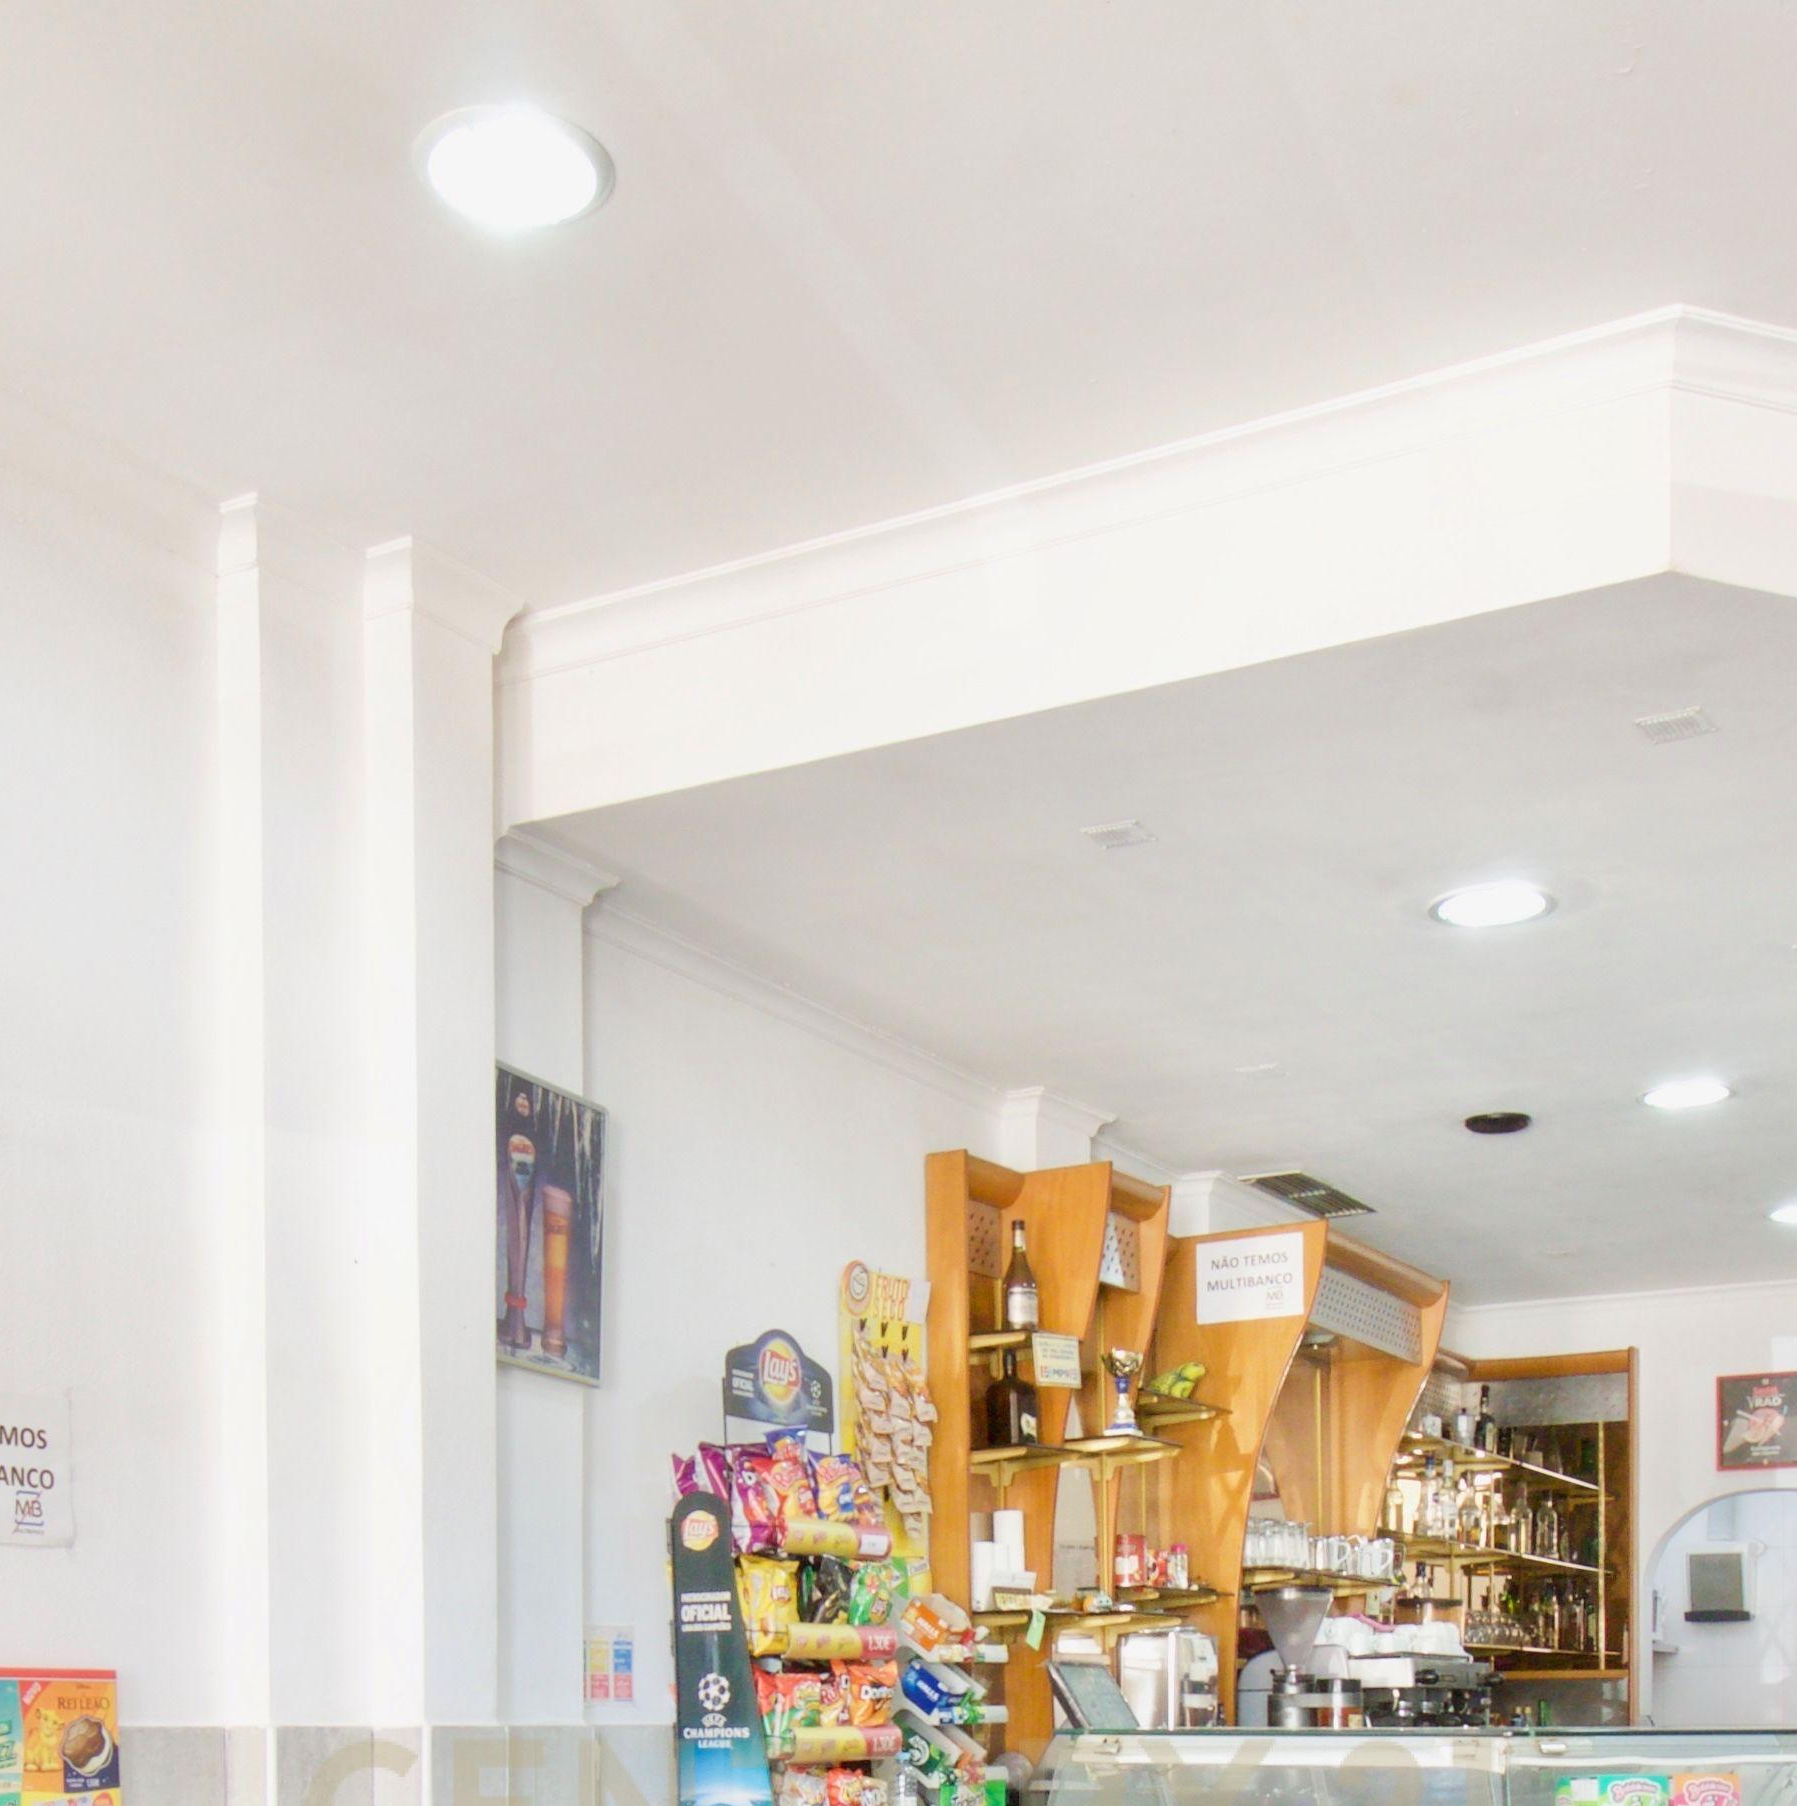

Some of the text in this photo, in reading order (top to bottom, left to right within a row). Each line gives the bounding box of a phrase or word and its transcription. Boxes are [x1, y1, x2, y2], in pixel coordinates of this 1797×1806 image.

[1210, 1251, 1288, 1270] NÃO TEMOS
[1206, 1272, 1294, 1292] MULTIBANCO
[14, 1498, 43, 1518] MB
[681, 1603, 733, 1622] OFICIAL
[683, 1727, 751, 1740] CHAMPIONS
[697, 1739, 732, 1749] LEAGUE
